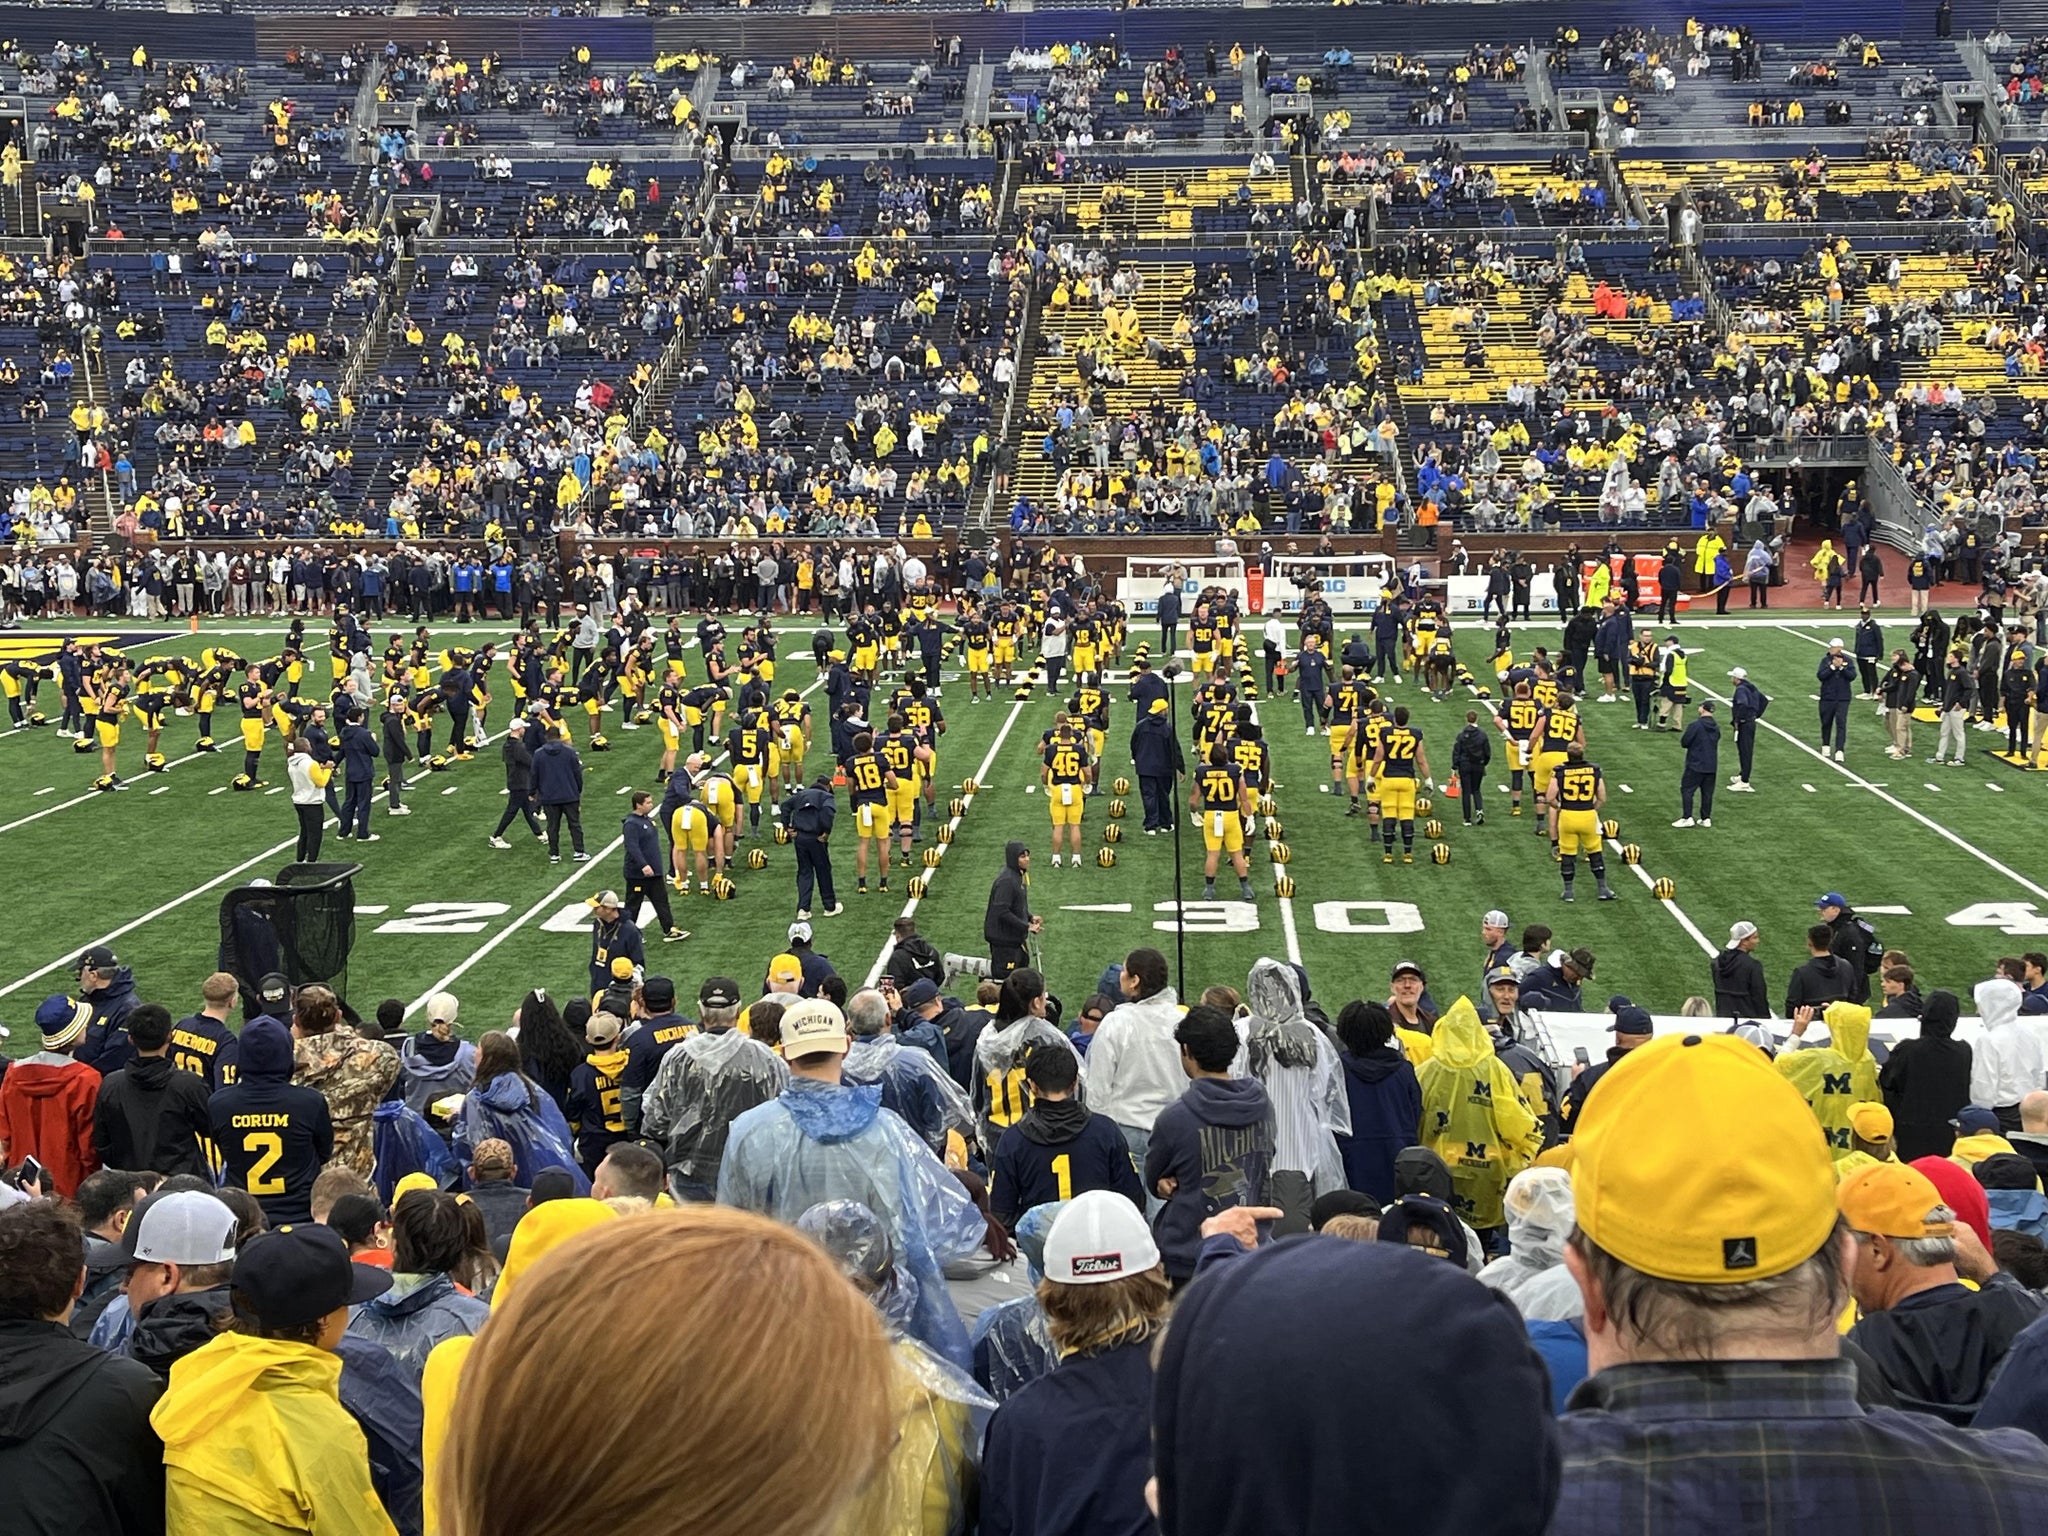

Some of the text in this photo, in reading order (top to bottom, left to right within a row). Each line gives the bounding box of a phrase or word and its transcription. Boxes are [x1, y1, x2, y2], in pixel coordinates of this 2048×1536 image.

[1338, 692, 1359, 712] 71
[1510, 706, 1537, 729] 50
[1548, 714, 1578, 742] 95
[742, 735, 757, 758] 5
[1387, 735, 1417, 760] 72
[1051, 751, 1080, 776] 46
[854, 763, 884, 790] 18
[1563, 775, 1595, 801] 53
[1202, 777, 1234, 802] 70
[792, 1014, 834, 1031] MICHIGAN
[1823, 1072, 1852, 1094] M
[232, 1113, 289, 1128] CORUM
[1823, 1126, 1851, 1149] M
[1466, 1142, 1487, 1158] M
[243, 1132, 286, 1195] 2
[1051, 1154, 1073, 1202] 1
[1074, 1257, 1120, 1274] Titleist
